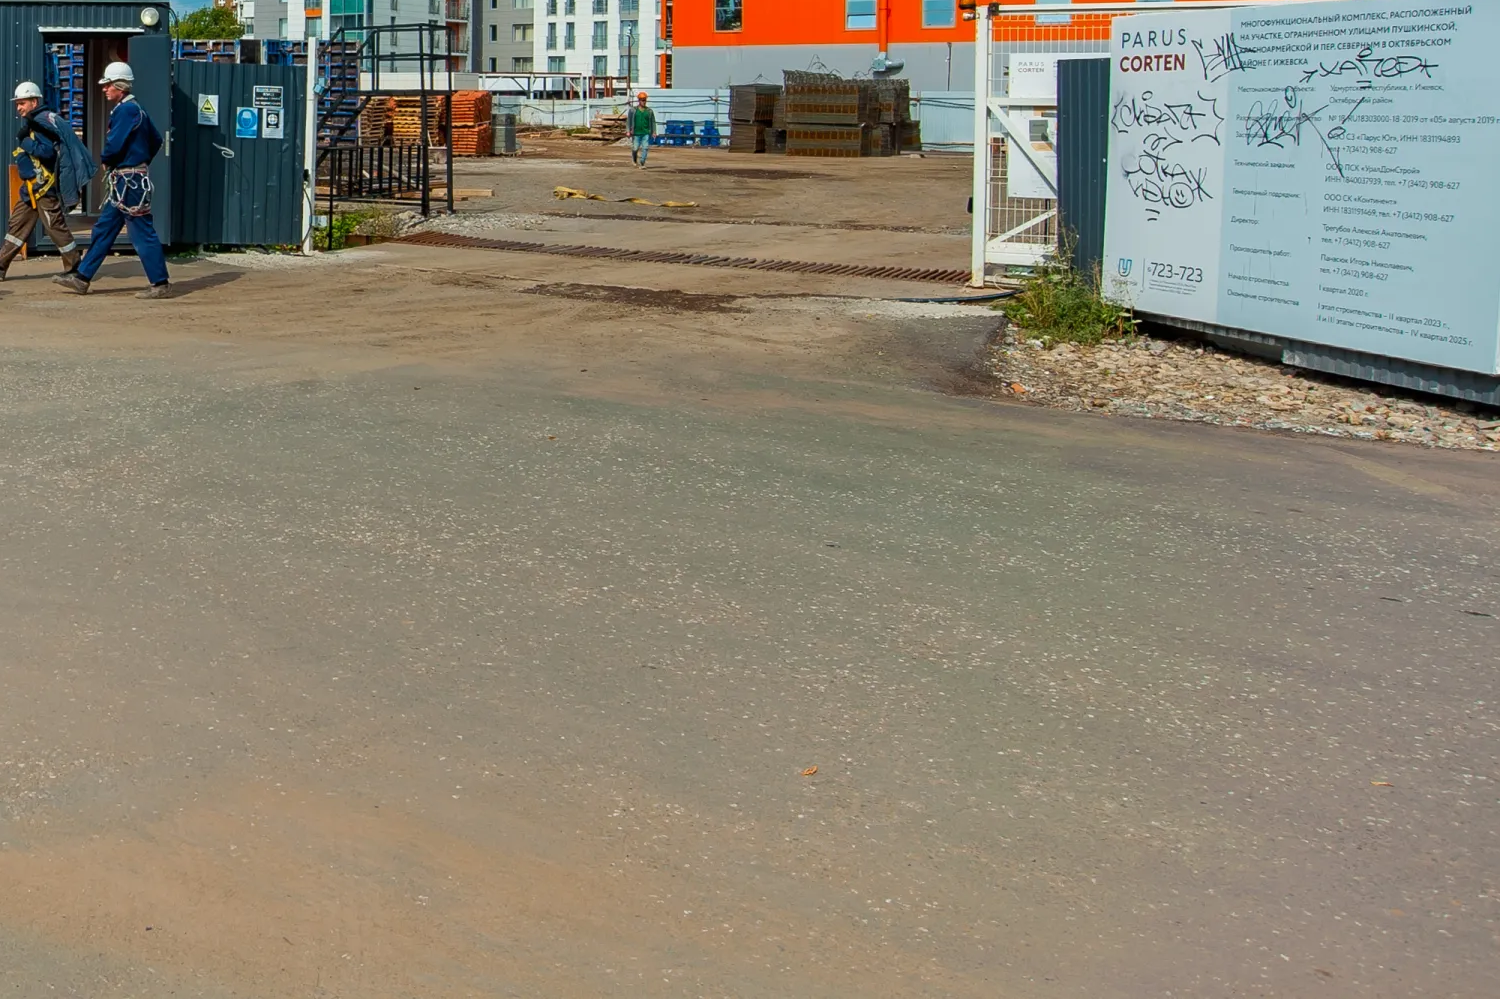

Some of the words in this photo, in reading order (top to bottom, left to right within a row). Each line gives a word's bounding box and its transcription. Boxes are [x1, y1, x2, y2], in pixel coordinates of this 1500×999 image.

[1240, 14, 1340, 28] МНОГОФУНКЦИОНАЛЬНЫЙ
[1342, 11, 1389, 22] КОМПЛЕКС,
[1390, 5, 1472, 19] РАСПОЛОЖЕННЫЙ
[1284, 28, 1347, 39] ОГРАНИЧЕННОМ
[1348, 26, 1390, 35] УЛИЦАМИ
[1392, 21, 1458, 33] ПУШКИНСКОЙ,
[1121, 28, 1187, 49] PARUS
[1313, 43, 1319, 51] И
[1321, 42, 1336, 51] ПЕР.
[1337, 40, 1380, 50] СЕВЕРНЫМ
[1388, 38, 1451, 48] ОКТЯБРЬСКОМ
[1119, 53, 1186, 72] CORTEN
[1273, 58, 1308, 66] ИЖЕВСКА
[1477, 116, 1496, 124] 2019
[1370, 146, 1398, 154] 908-627
[1324, 175, 1341, 183] ИНН
[1407, 179, 1428, 189] (3412)
[1429, 180, 1460, 190] 908-627
[1323, 193, 1342, 201] ООО
[1342, 194, 1353, 202] СК
[1401, 211, 1423, 222] (3412)
[1423, 213, 1455, 222] 908-627
[1351, 226, 1380, 235] Алексей
[1342, 237, 1362, 248] (3412)
[1362, 239, 1391, 250] 908-627
[1349, 256, 1370, 266] Игорь
[1150, 262, 1203, 283] 723-723
[1340, 268, 1360, 279] (3412)
[1360, 270, 1389, 281] 908-627
[1322, 286, 1347, 294] квартал
[1347, 287, 1364, 297] 2020
[1395, 315, 1423, 324] квартал
[1423, 317, 1442, 328] 2023
[1419, 332, 1448, 341] квартал
[1448, 335, 1468, 346] 2025
